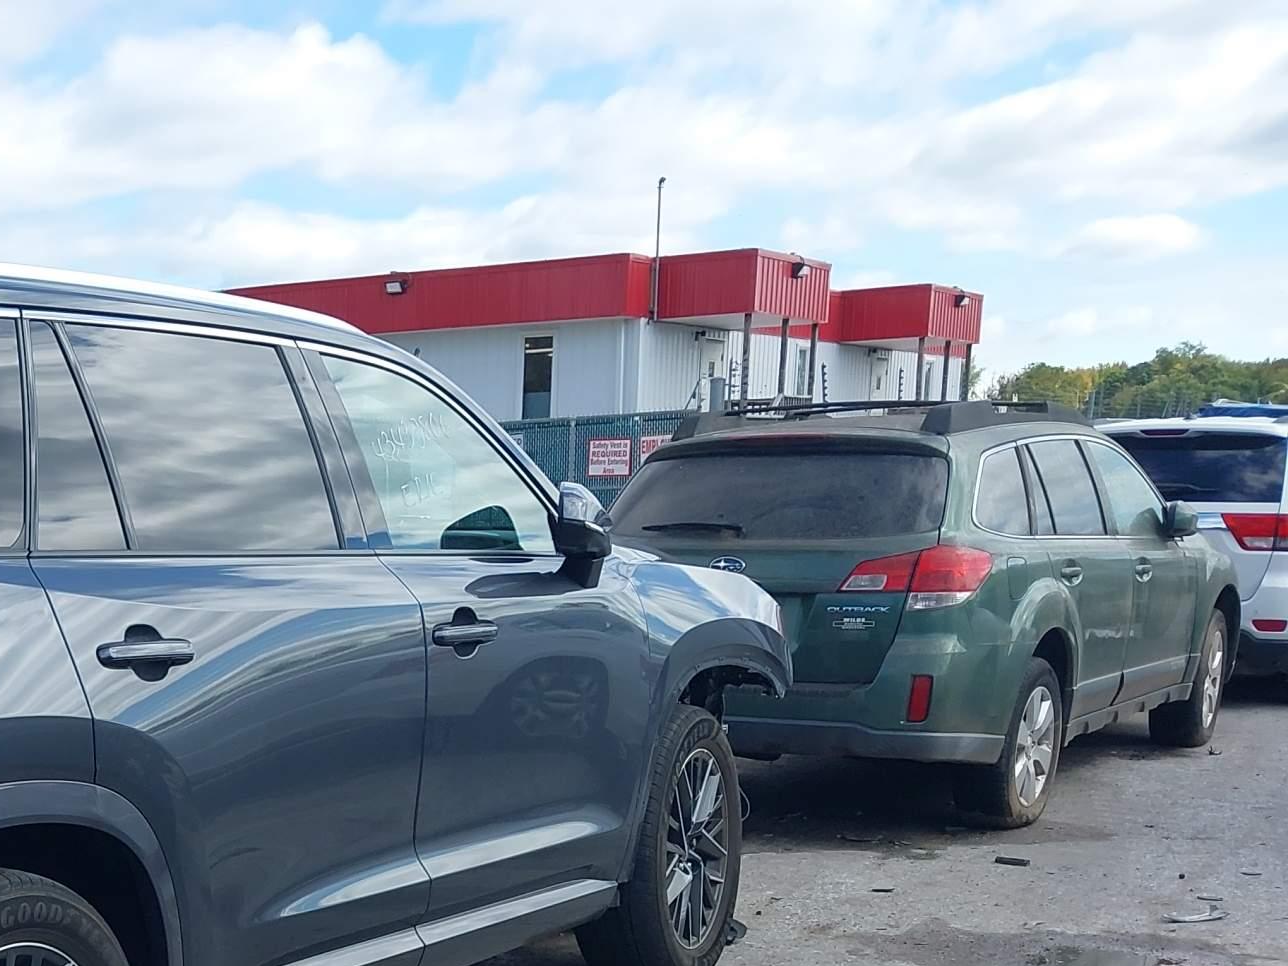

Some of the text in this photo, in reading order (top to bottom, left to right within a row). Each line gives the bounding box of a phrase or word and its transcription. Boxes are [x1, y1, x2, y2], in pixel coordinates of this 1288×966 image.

[592, 441, 609, 451] Safety
[610, 441, 623, 449] Vest
[592, 450, 628, 458] REQUIRED
[591, 458, 628, 467] Before Entering
